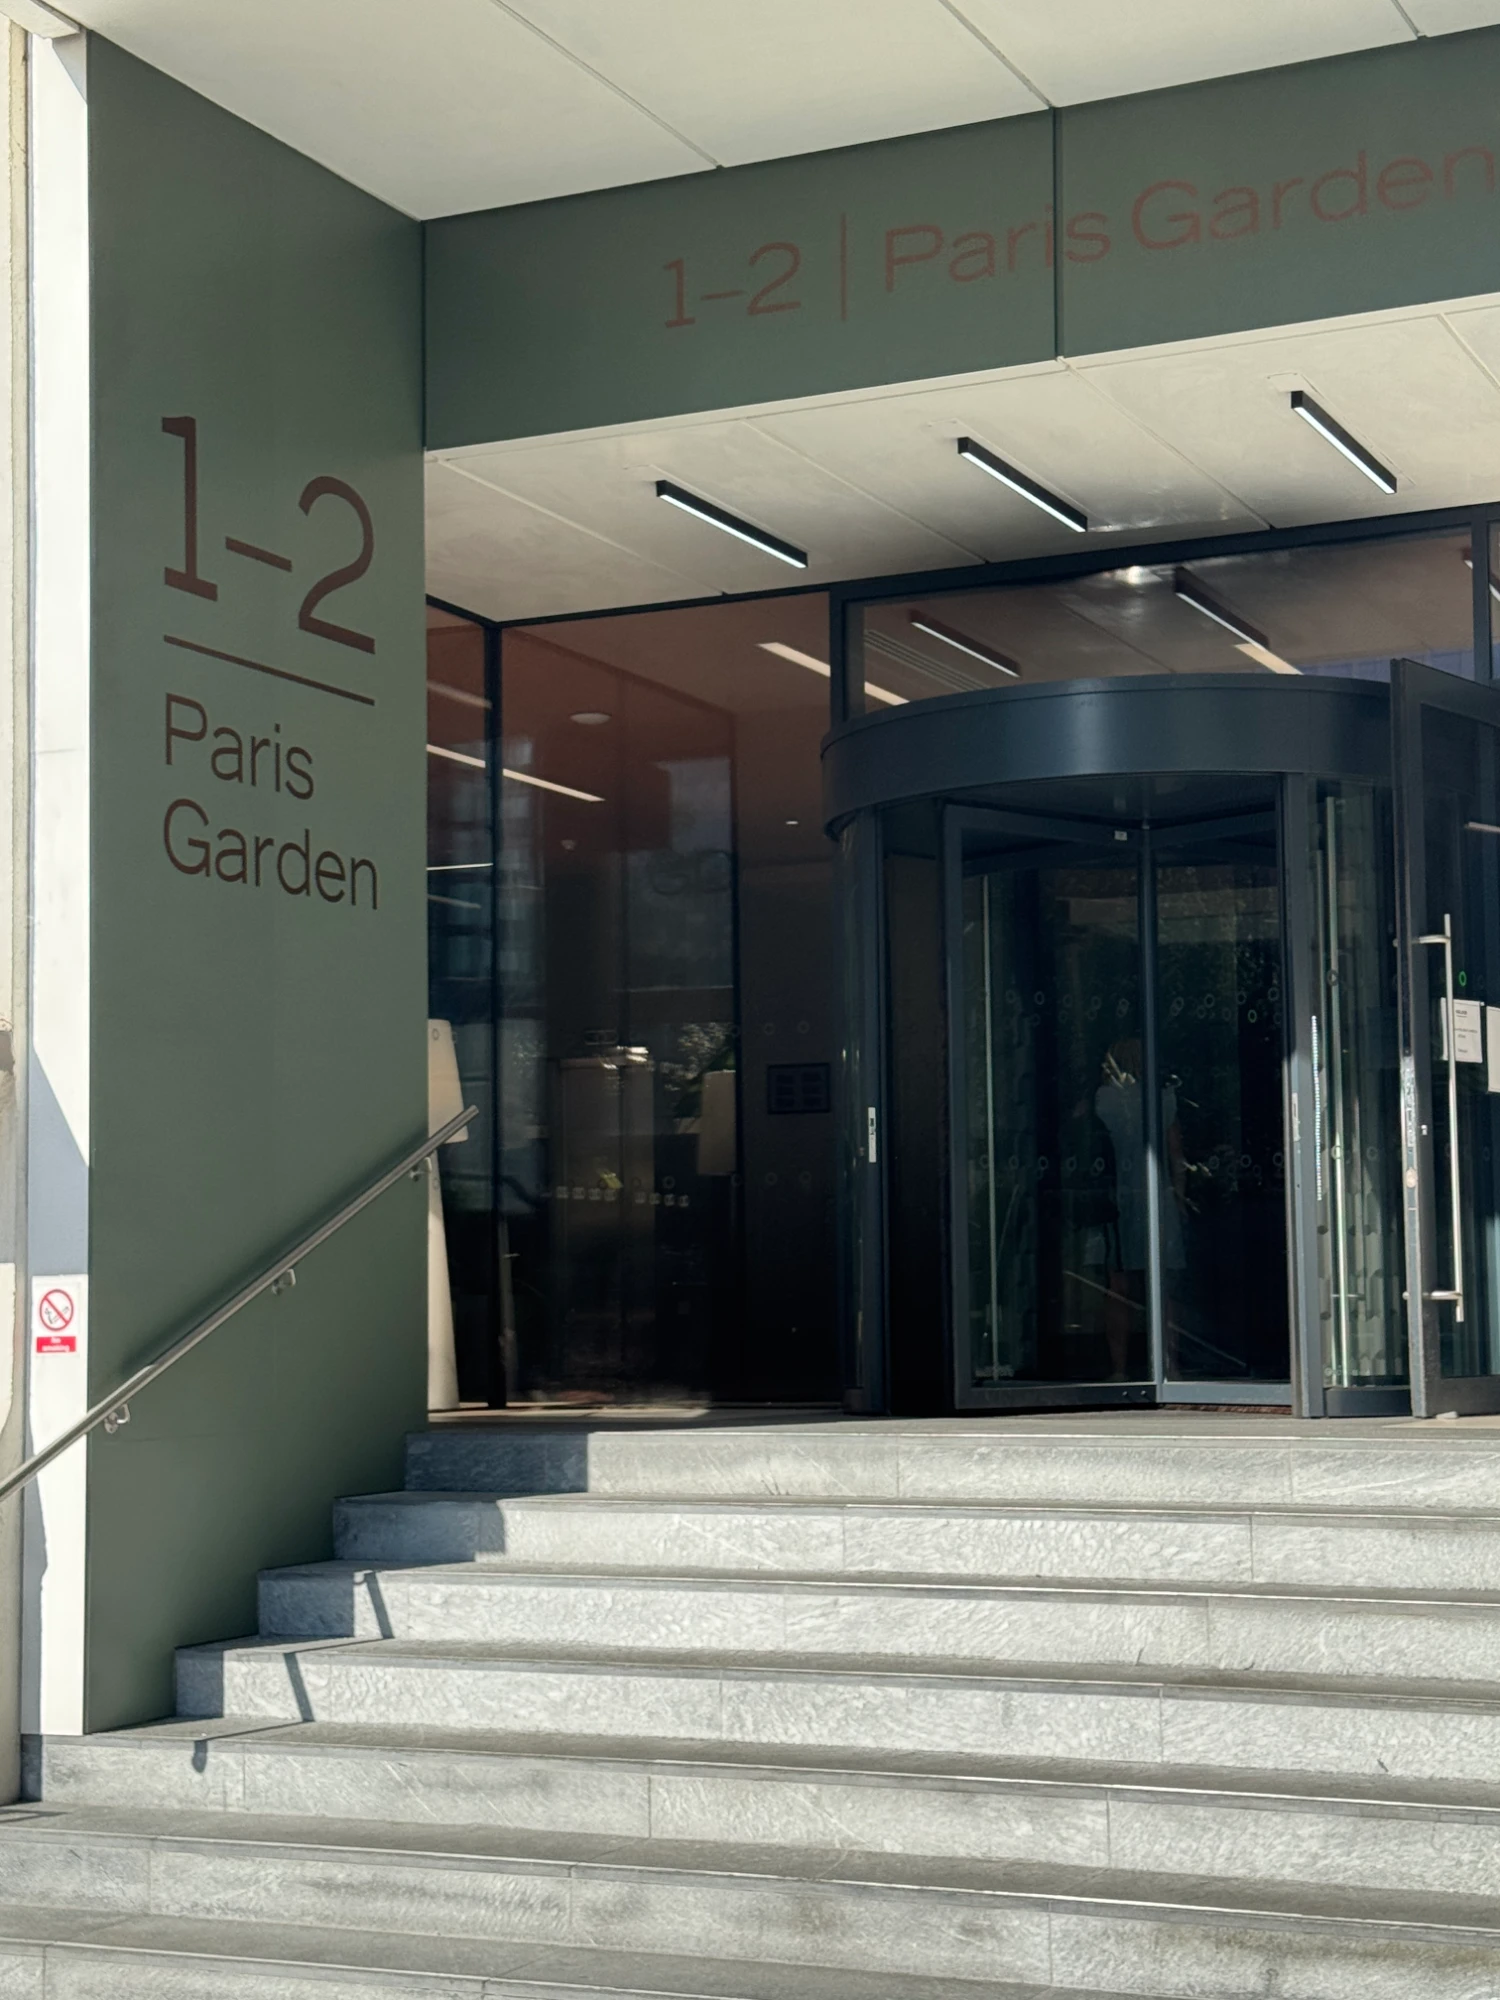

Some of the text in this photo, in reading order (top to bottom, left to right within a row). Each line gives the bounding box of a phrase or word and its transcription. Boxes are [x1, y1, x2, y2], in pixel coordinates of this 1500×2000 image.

[885, 203, 1111, 292] Paris
[1131, 144, 1496, 250] Garden
[165, 693, 315, 800] Paris
[163, 798, 378, 910] Garden
